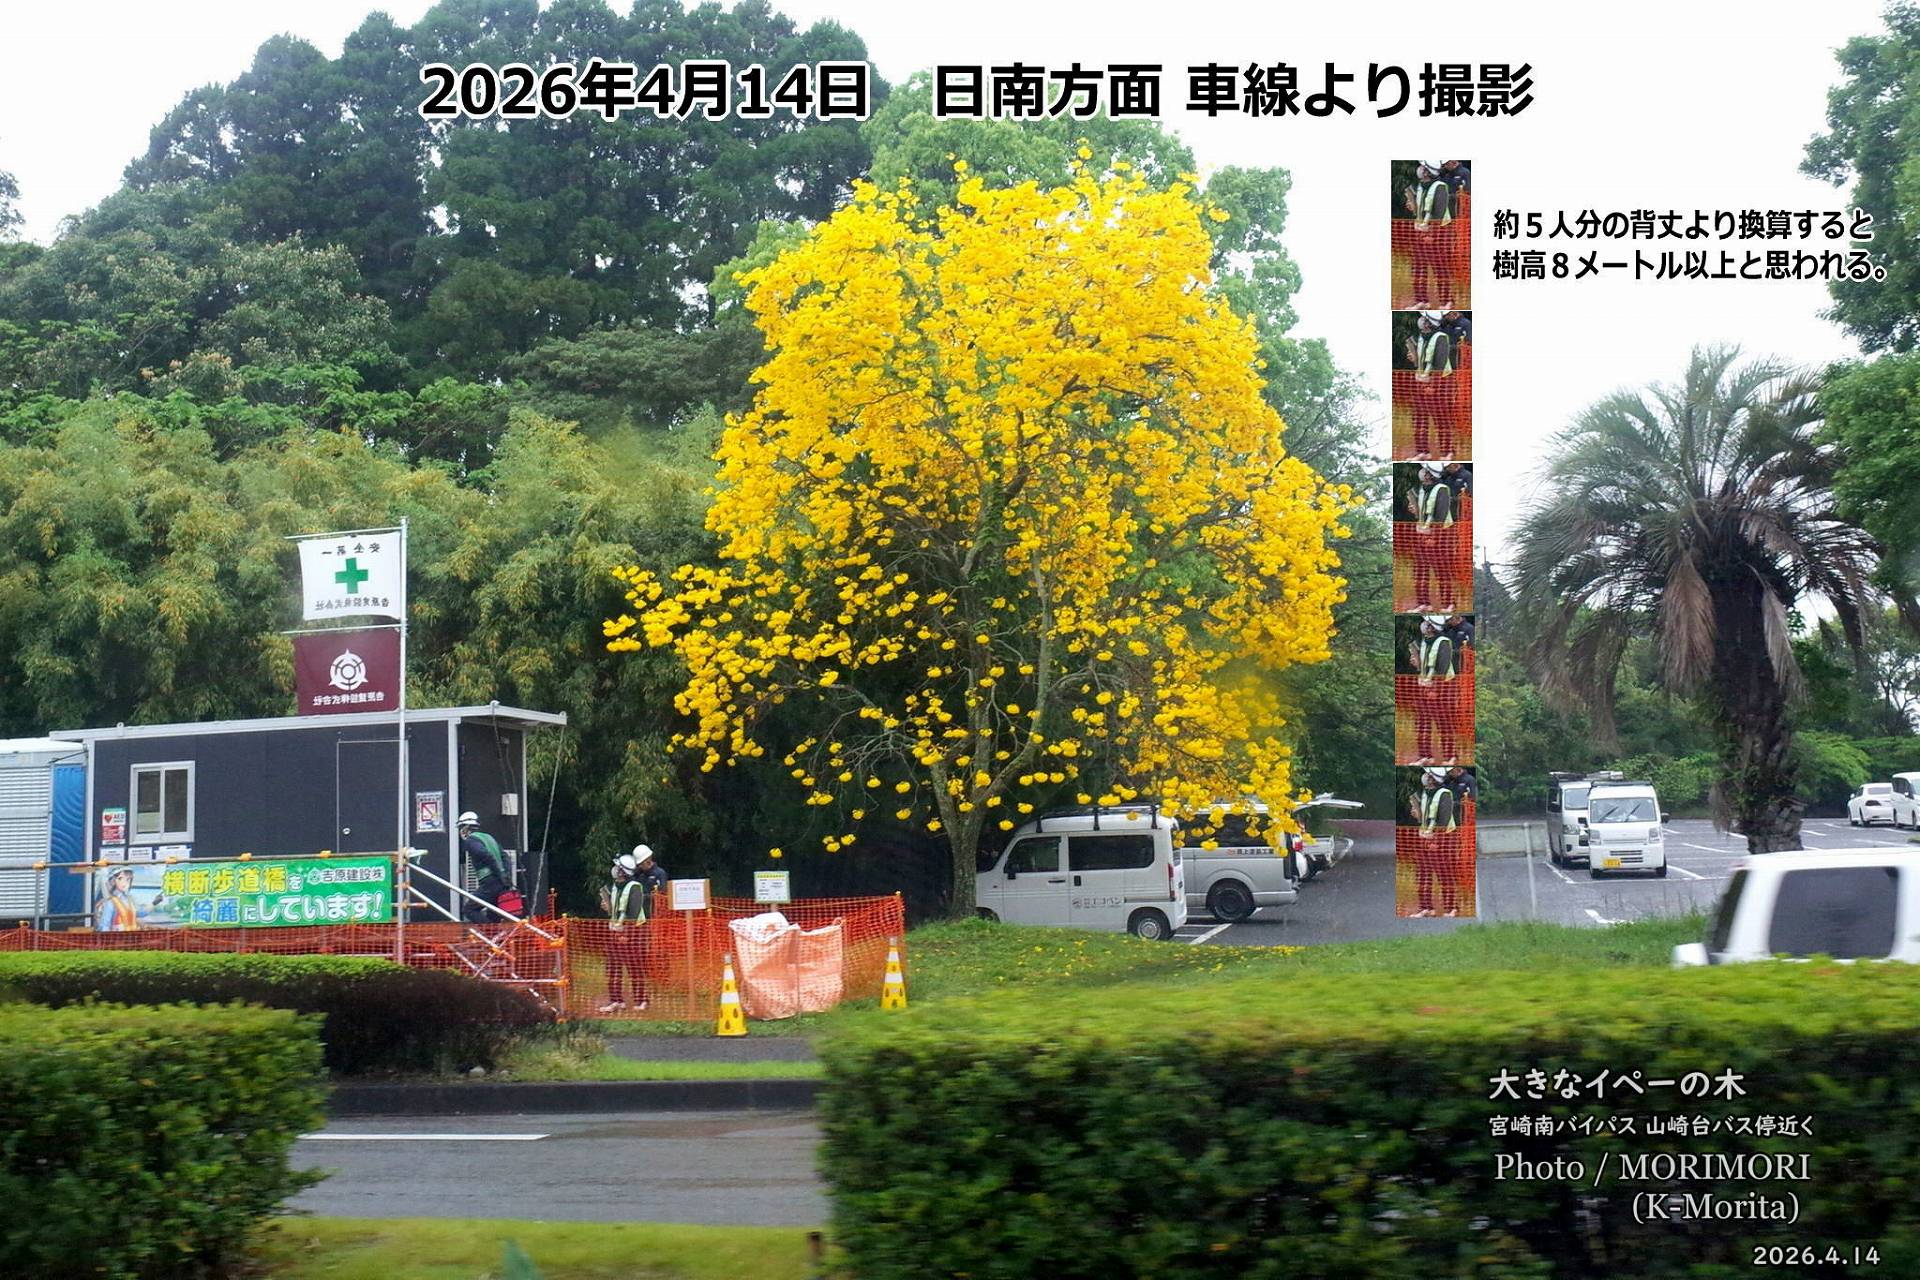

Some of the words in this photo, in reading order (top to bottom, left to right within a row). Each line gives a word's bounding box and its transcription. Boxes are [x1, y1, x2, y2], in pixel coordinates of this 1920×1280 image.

[163, 866, 303, 895] 横断歩道橋を
